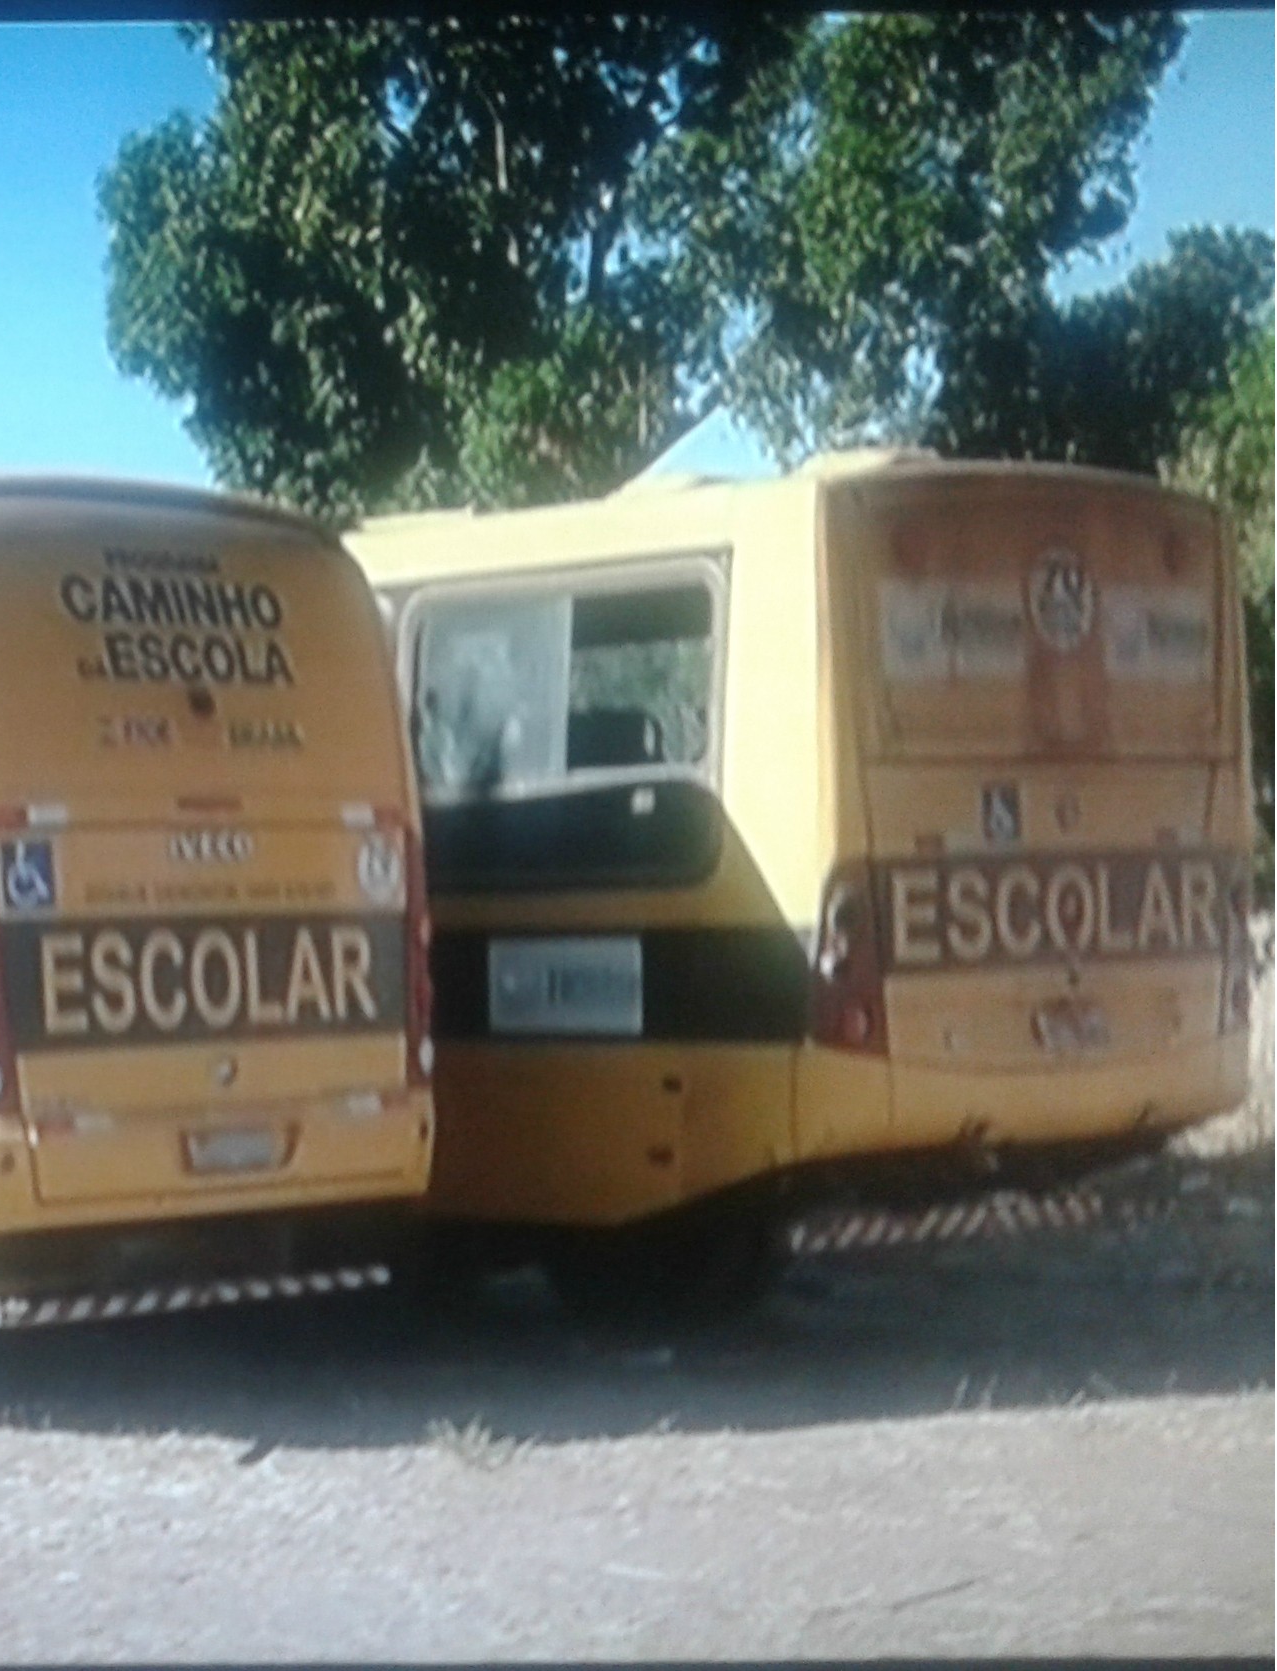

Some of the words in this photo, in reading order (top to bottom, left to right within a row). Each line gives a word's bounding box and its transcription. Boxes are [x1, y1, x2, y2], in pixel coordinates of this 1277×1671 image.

[60, 574, 283, 629] CAMINHO
[104, 632, 295, 685] ESCOLA
[891, 859, 1220, 962] ESCOLAR
[40, 928, 377, 1035] ESCOLAR
